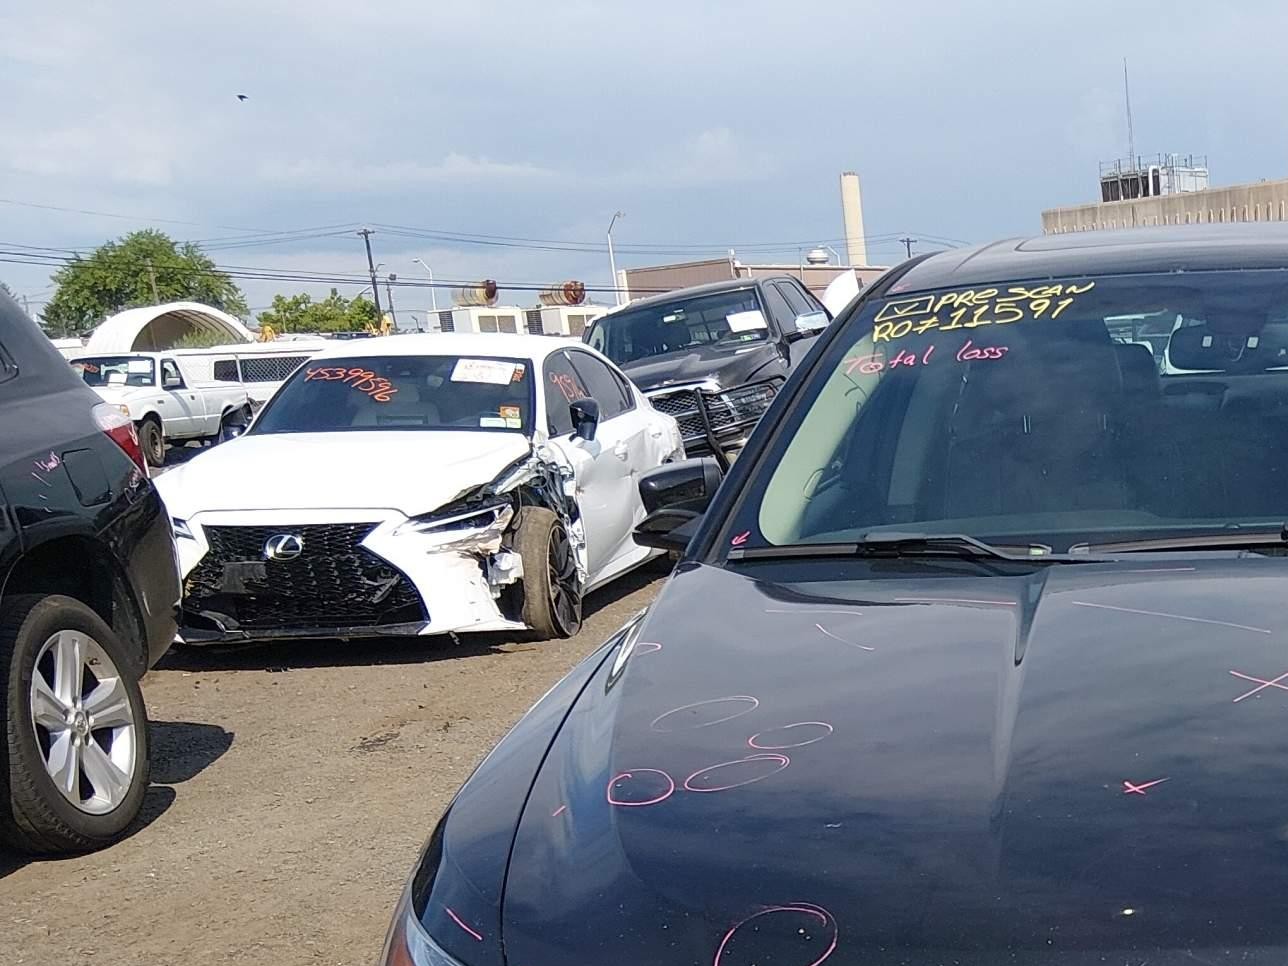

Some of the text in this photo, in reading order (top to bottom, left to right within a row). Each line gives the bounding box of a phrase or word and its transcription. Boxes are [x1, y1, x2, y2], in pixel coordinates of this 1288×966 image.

[997, 282, 1095, 302] SCAN
[844, 340, 1008, 375] Total loss
